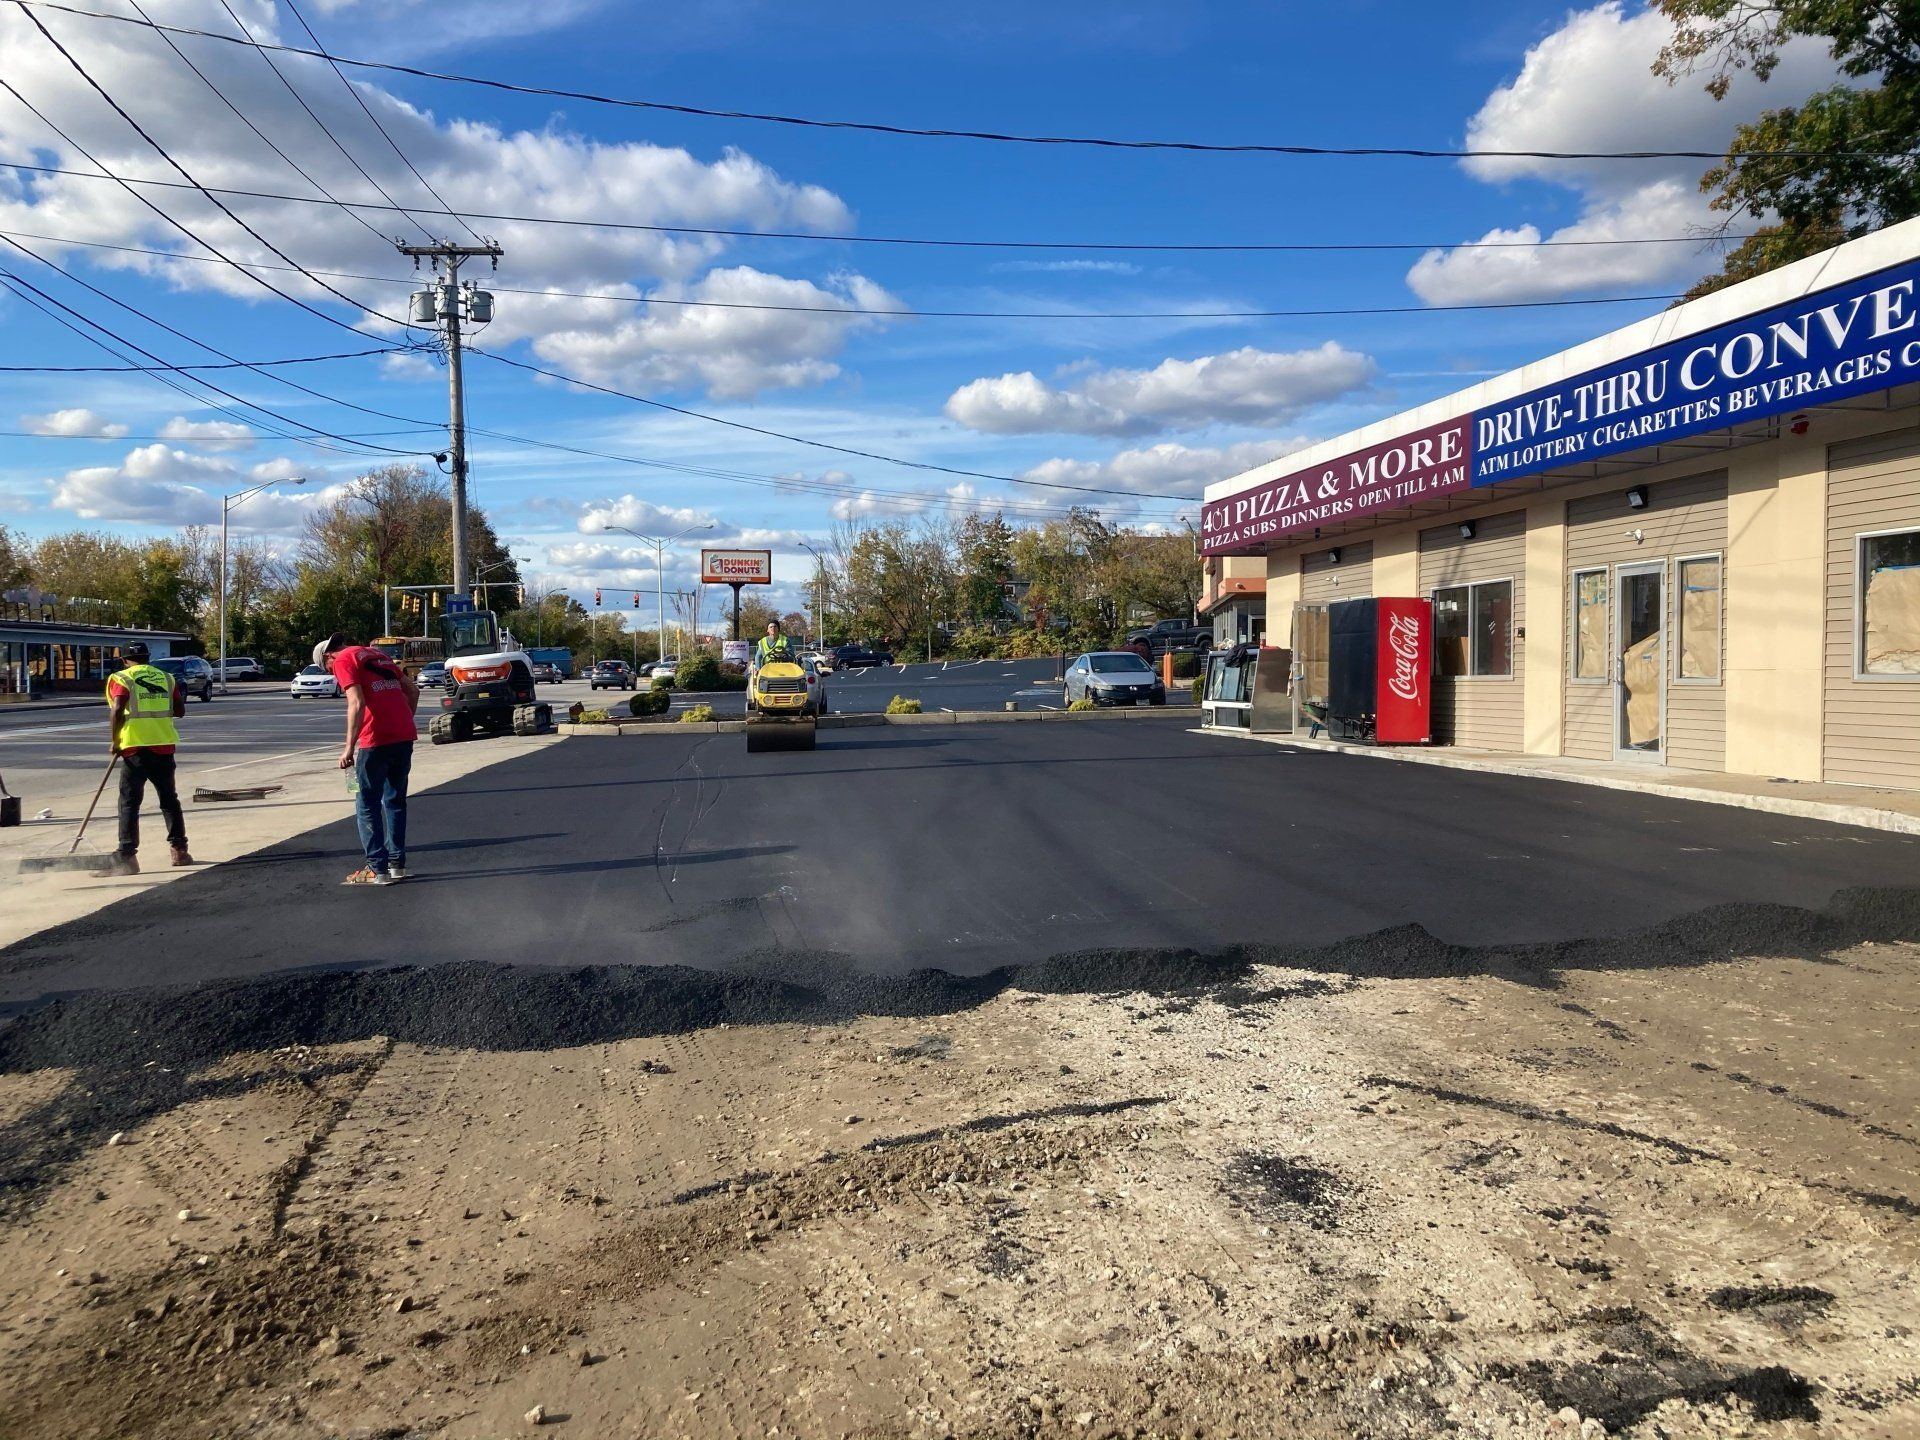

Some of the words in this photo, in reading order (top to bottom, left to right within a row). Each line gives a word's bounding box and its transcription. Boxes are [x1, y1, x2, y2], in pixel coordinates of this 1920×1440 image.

[1477, 359, 1669, 452] DRIVE-THRU
[1680, 279, 1917, 391] CONVE
[1478, 453, 1509, 477] ATM
[1513, 432, 1588, 467] LOTTERY
[1593, 396, 1721, 447] CIGARETTES
[1727, 349, 1892, 413] BEVERAGES
[1203, 505, 1230, 533] 401
[1235, 480, 1311, 525] PIZZA
[1317, 470, 1340, 499] &
[1348, 427, 1463, 491] MORE
[1358, 486, 1392, 508] OPEN
[1395, 477, 1427, 499] TILL
[1430, 472, 1438, 488] 4
[1441, 465, 1465, 486] AM
[1203, 531, 1240, 550] PIZZA
[1243, 519, 1277, 539] SUBS
[1281, 498, 1354, 529] DINNERS
[476, 670, 496, 678] Bobcat
